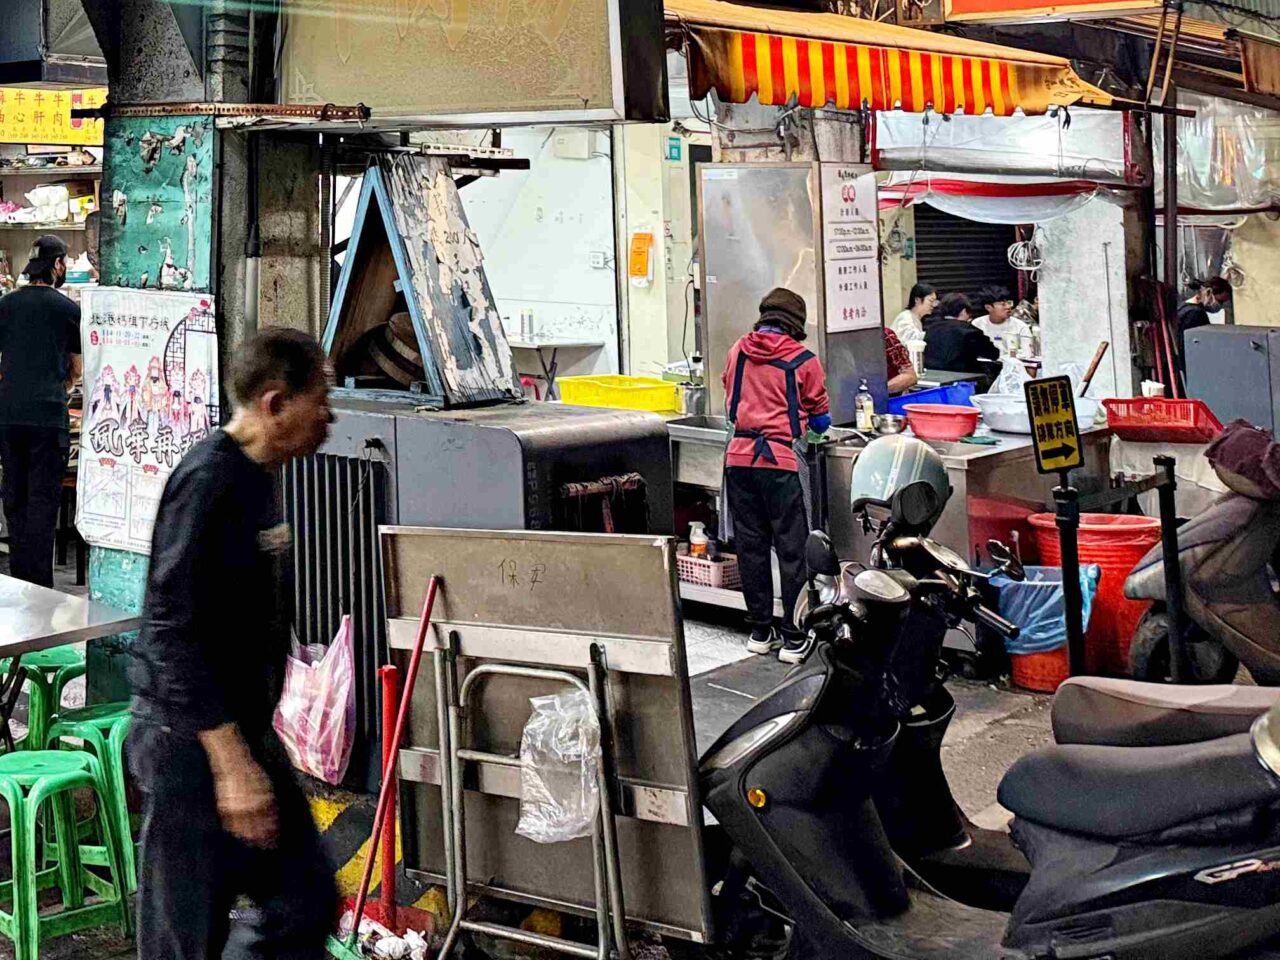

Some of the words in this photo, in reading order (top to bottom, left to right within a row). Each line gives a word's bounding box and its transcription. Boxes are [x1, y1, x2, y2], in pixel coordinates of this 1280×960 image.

[13, 90, 26, 123] 牛心
[33, 91, 46, 124] 牛肝
[52, 92, 65, 127] 牛肉
[498, 557, 547, 592] 保安
